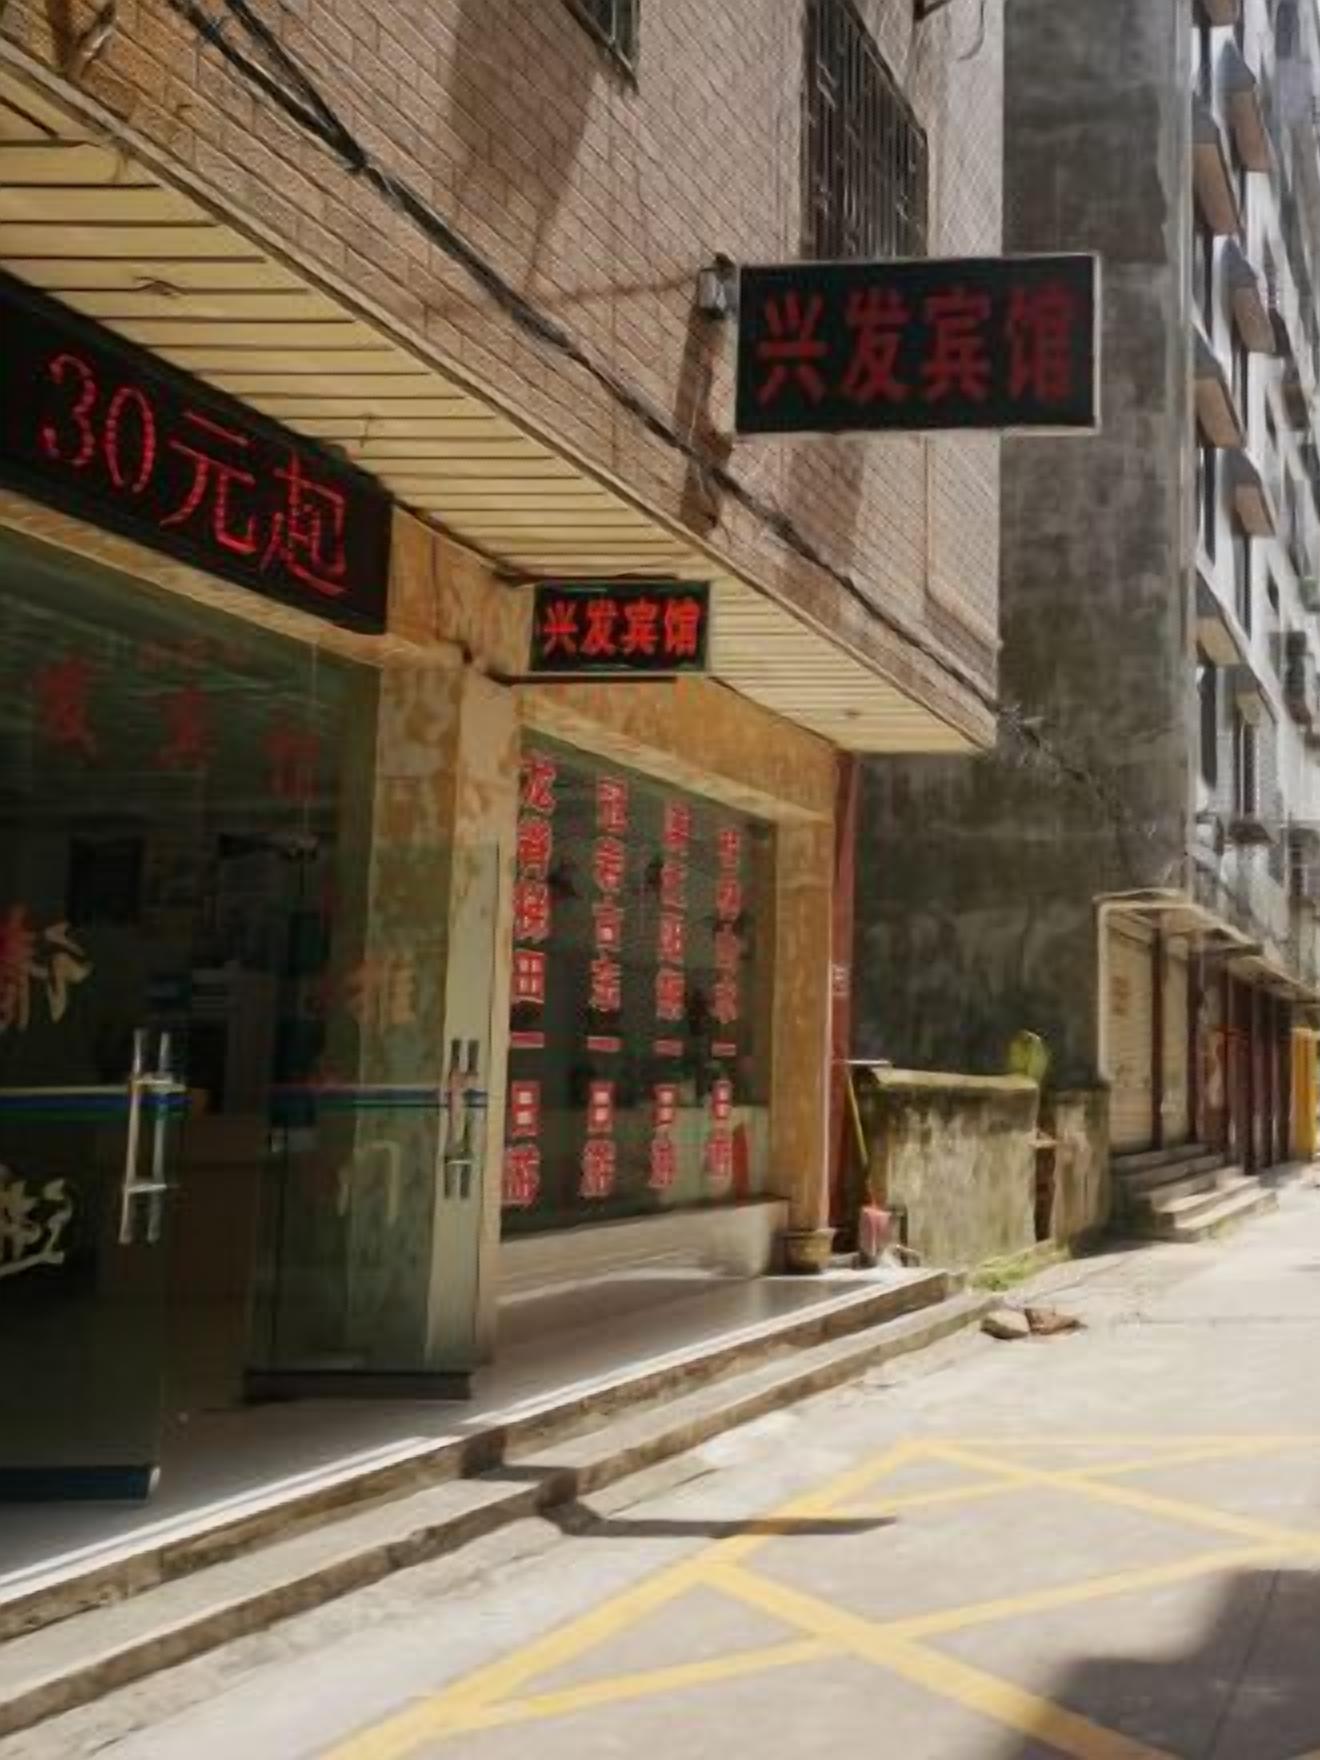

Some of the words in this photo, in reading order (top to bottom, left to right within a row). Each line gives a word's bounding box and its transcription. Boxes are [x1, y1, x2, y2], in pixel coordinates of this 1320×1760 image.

[756, 283, 1074, 403] 兴发宾馆
[41, 352, 348, 597] 30元起
[543, 596, 701, 656] 兴发宾馆
